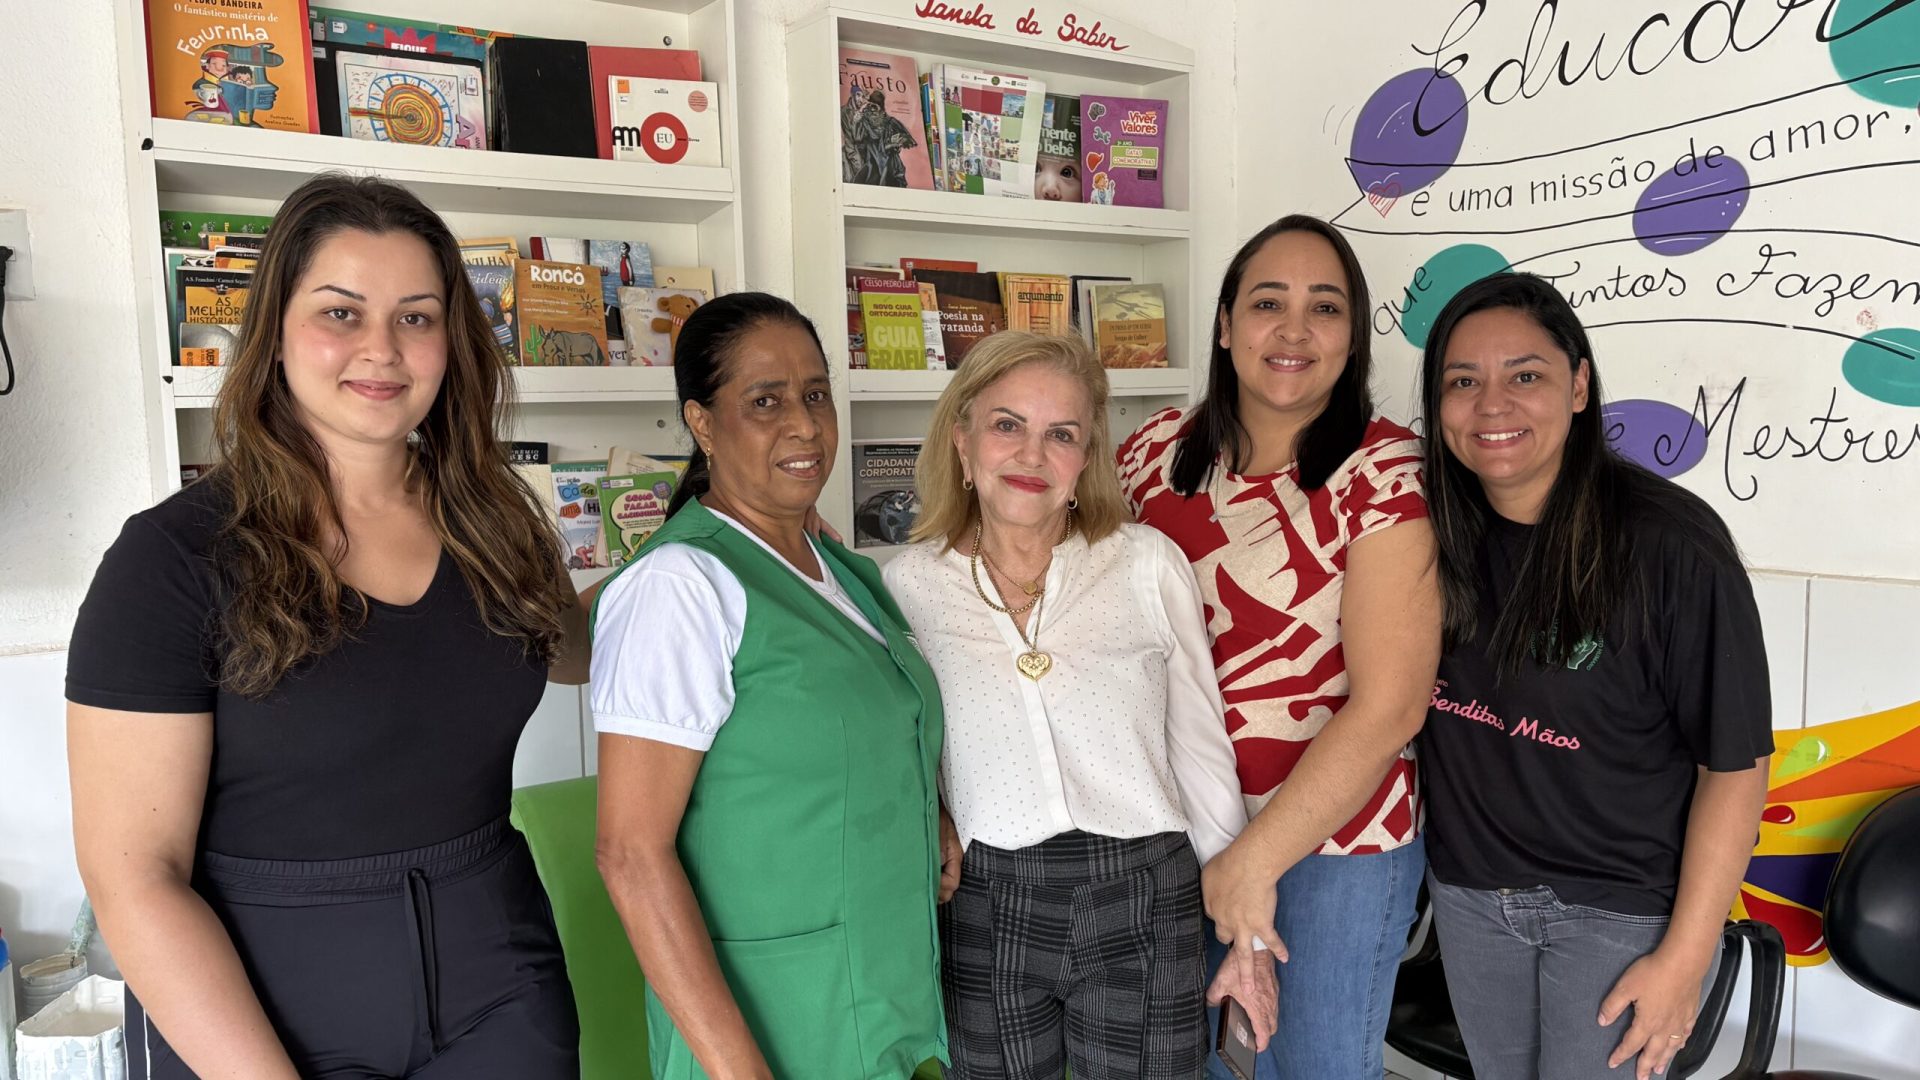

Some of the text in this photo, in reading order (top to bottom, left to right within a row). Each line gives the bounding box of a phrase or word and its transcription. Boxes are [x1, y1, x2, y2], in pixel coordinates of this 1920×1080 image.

[221, 0, 263, 9] BANDEIRA
[173, 3, 279, 22] O fantástico mistério de
[1057, 13, 1130, 51] Saber
[176, 23, 269, 56] Feiurinha
[1129, 111, 1156, 124] Viver
[1121, 120, 1157, 134] Valores
[1411, 181, 1436, 216] é
[1448, 186, 1513, 212] uma
[1529, 156, 1656, 204] missão
[1673, 138, 1725, 177] de
[864, 279, 917, 288] CELSO PEDRO LUFT
[215, 296, 231, 307] AS
[1017, 291, 1064, 303] argumento
[1373, 264, 1433, 336] que
[938, 310, 985, 321] Poesia na
[940, 323, 985, 333] varanda
[866, 458, 915, 467] CIDADANI
[860, 467, 915, 477] CORPORATI
[1509, 716, 1581, 750] Mãos
